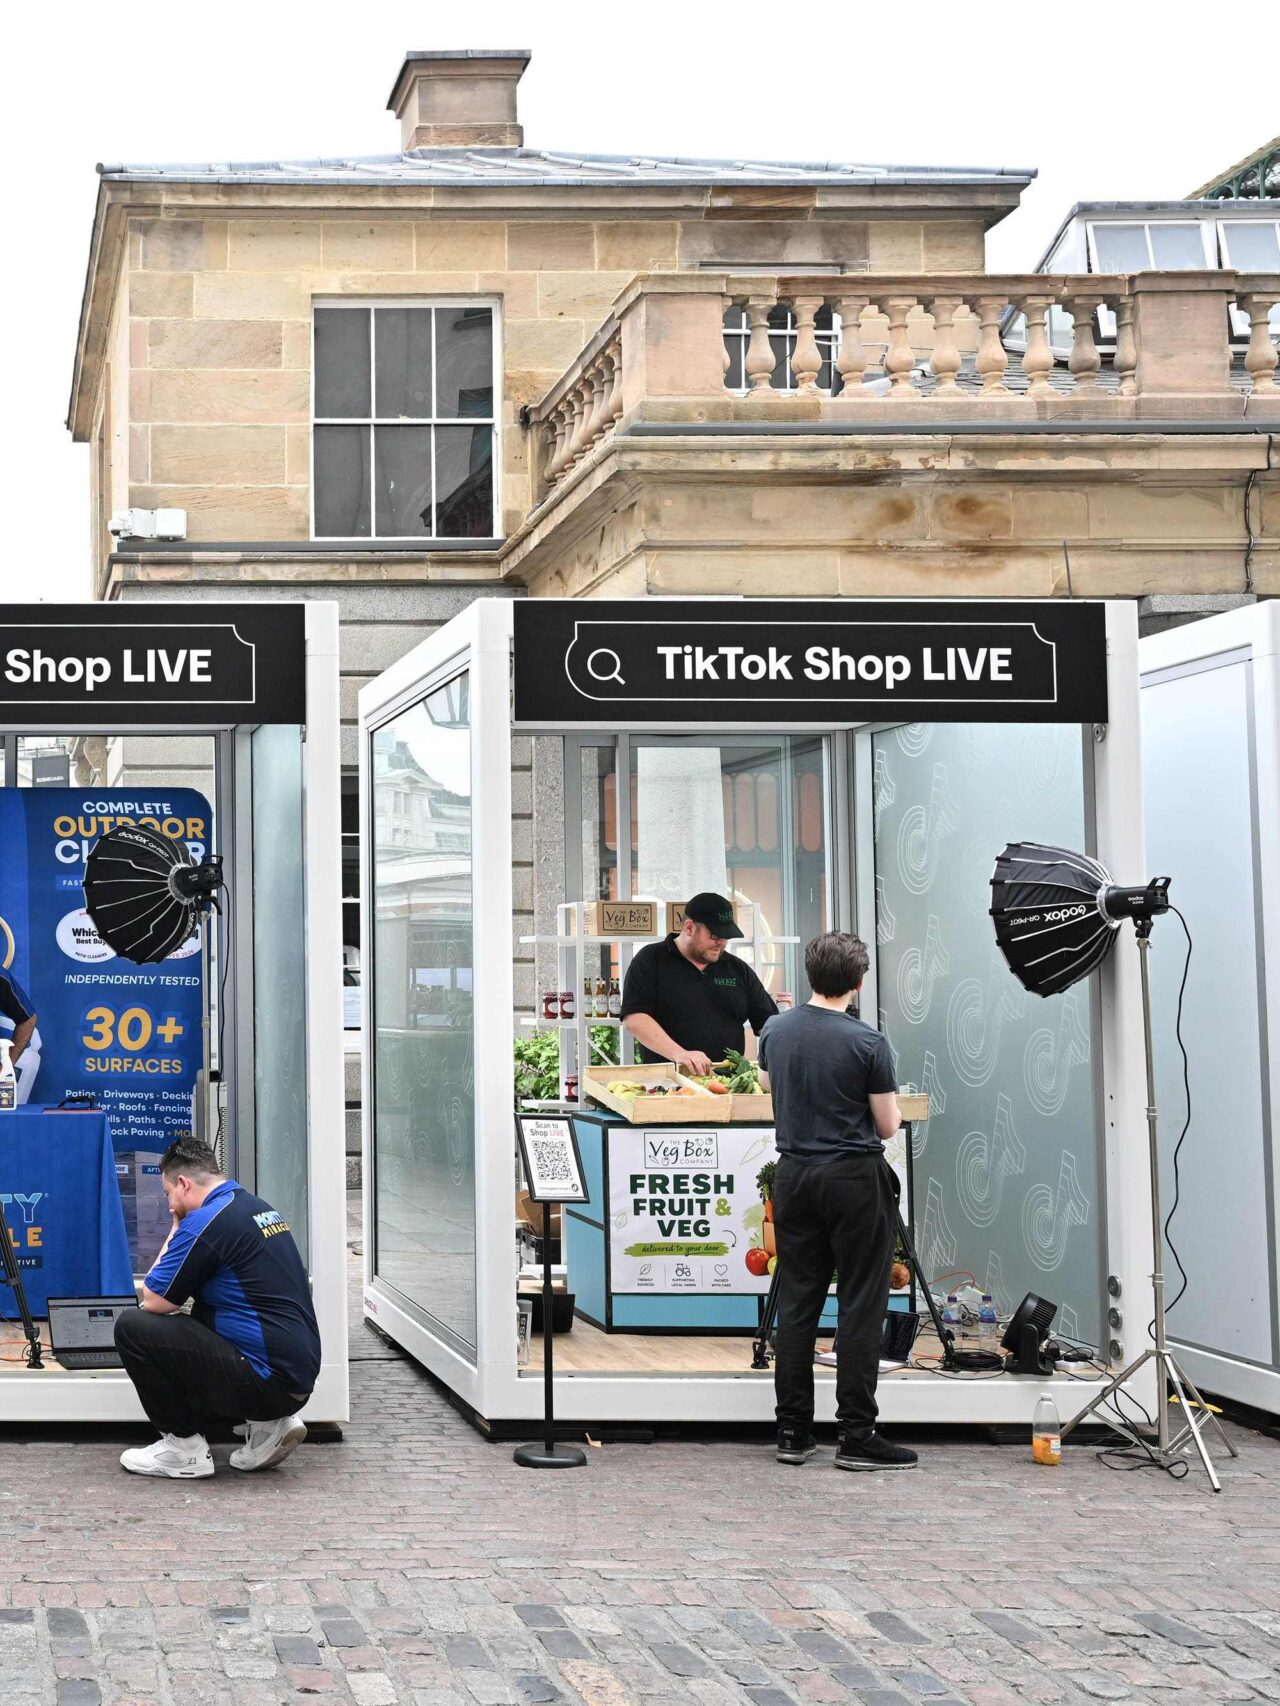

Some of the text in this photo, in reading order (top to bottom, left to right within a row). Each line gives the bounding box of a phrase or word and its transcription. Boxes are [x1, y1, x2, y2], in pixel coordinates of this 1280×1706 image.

[4, 649, 112, 691] Shop
[123, 649, 212, 682] LIVE
[657, 645, 1013, 689] TikTok Shop LIVE
[82, 801, 173, 815] COMPLETE
[606, 910, 625, 928] Veg
[628, 909, 650, 923] Box
[1043, 904, 1087, 922] Godox
[72, 928, 98, 937] Whic
[65, 974, 200, 986] INDEPENDENTLY TESTED
[82, 1007, 184, 1051] 30+
[85, 1057, 183, 1074] SURFACES
[103, 1089, 155, 1100] Driveways
[162, 1091, 192, 1100] Decki
[119, 1102, 146, 1111] Roofs
[154, 1103, 192, 1114] Fencing
[128, 1115, 156, 1124] Paths
[163, 1116, 192, 1125] Conc
[535, 1121, 551, 1129] Scan
[111, 1127, 129, 1135] ock
[131, 1127, 164, 1138] Paving
[529, 1128, 565, 1137] Shop LIVE
[649, 1137, 714, 1165] Veg Box
[629, 1173, 734, 1195] FRESH
[633, 1197, 732, 1217] FRUIT &
[657, 1219, 711, 1238] VEG
[684, 1246, 702, 1257] your
